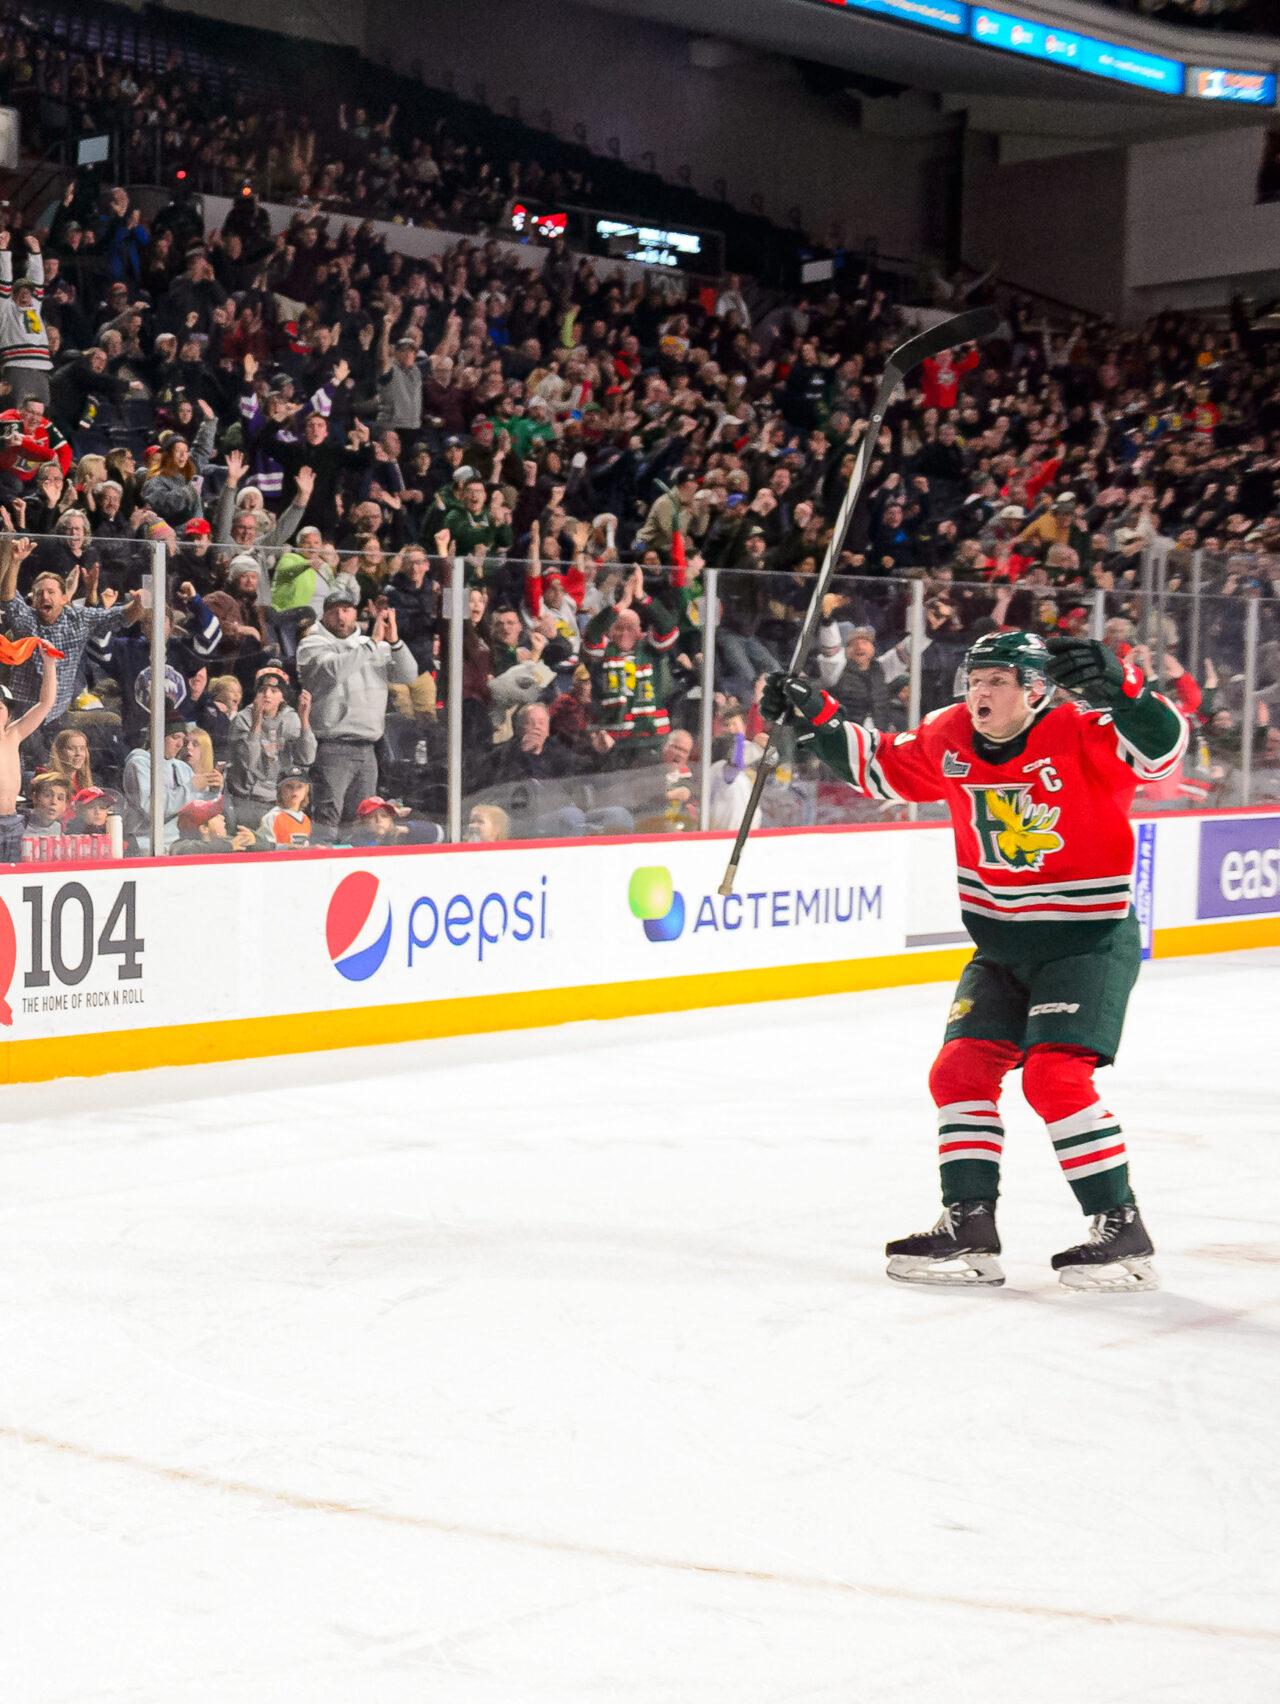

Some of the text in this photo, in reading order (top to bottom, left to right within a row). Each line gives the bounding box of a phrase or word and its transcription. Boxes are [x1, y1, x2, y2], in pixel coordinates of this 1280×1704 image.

[1039, 766, 1063, 793] C
[1222, 847, 1280, 902] eas
[407, 875, 547, 968] pepsi
[693, 885, 883, 933] ACTEMIUM
[22, 988, 144, 1013] THE HOME OF ROCK N ROLL
[1028, 1002, 1080, 1017] CCM
